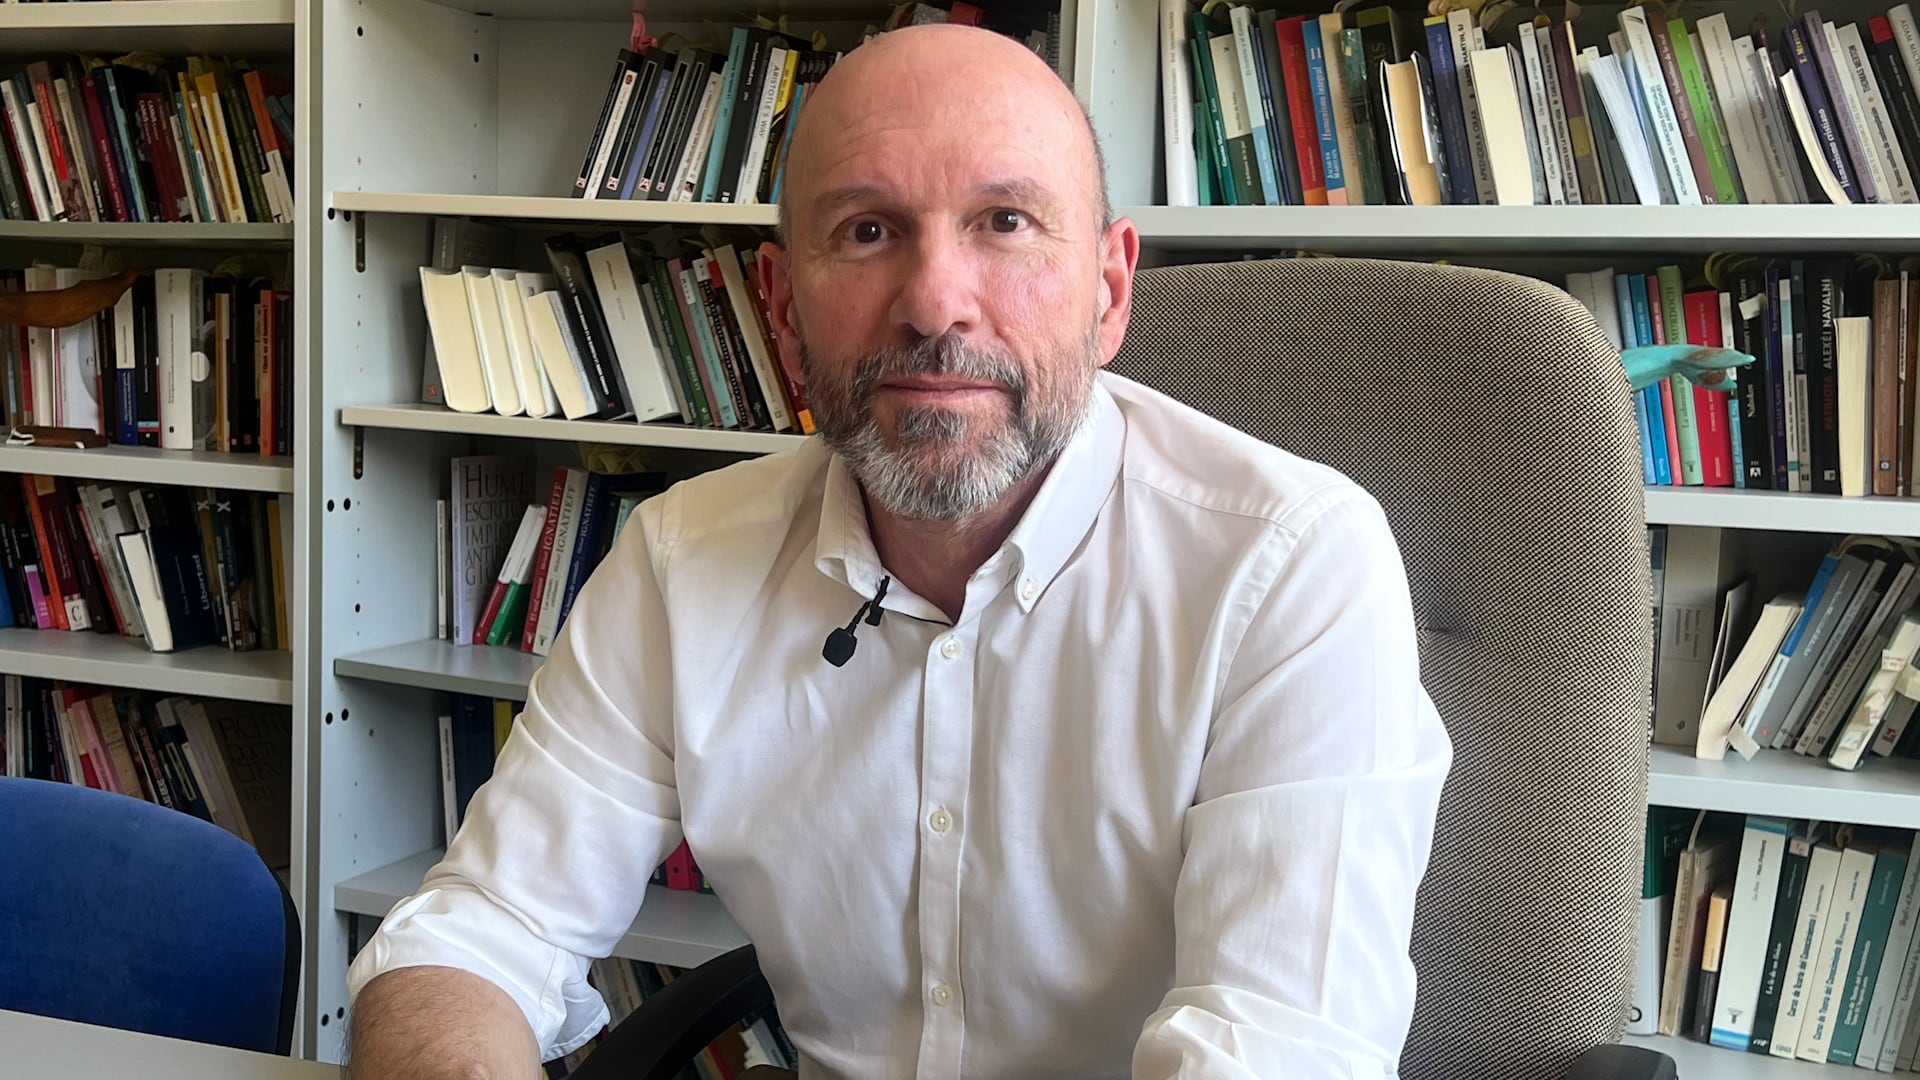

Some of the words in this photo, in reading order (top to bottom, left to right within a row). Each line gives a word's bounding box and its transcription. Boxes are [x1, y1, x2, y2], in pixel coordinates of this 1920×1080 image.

[1815, 107, 1834, 142] cristiano
[1826, 141, 1849, 188] Humanismo
[1665, 285, 1680, 341] MURDOCH
[1821, 278, 1831, 327] NAVALNI
[542, 481, 563, 550] IGNATIEFF
[555, 485, 575, 553] IGNATIEFF
[192, 553, 209, 610] Libertad
